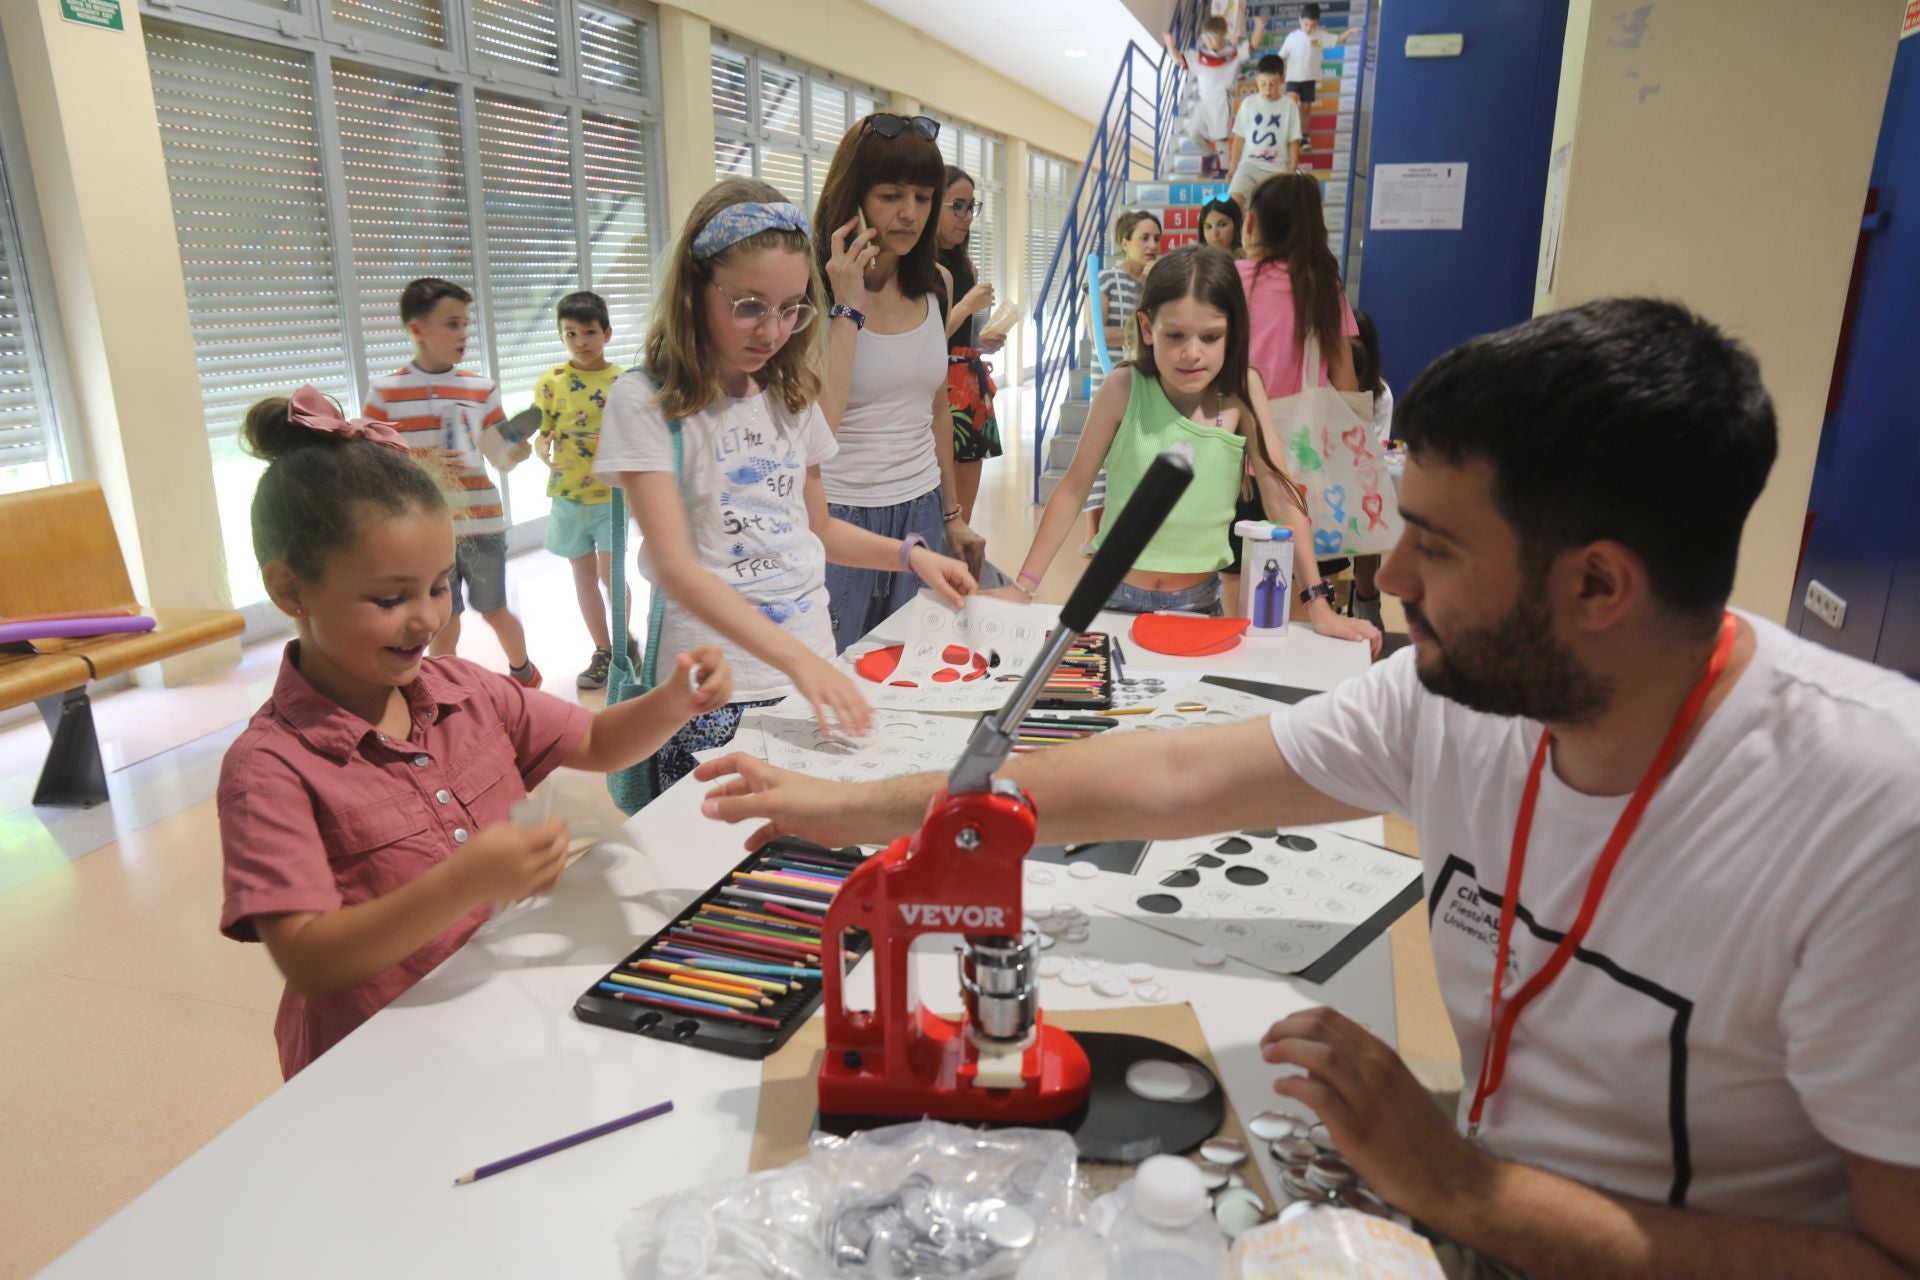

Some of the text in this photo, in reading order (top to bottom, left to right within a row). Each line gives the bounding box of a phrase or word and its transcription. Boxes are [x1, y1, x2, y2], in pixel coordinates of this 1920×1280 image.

[1179, 188, 1187, 201] 6
[1174, 212, 1182, 226] 5
[1167, 238, 1176, 250] 4
[715, 426, 740, 462] LET
[898, 903, 1005, 928] VEVOR
